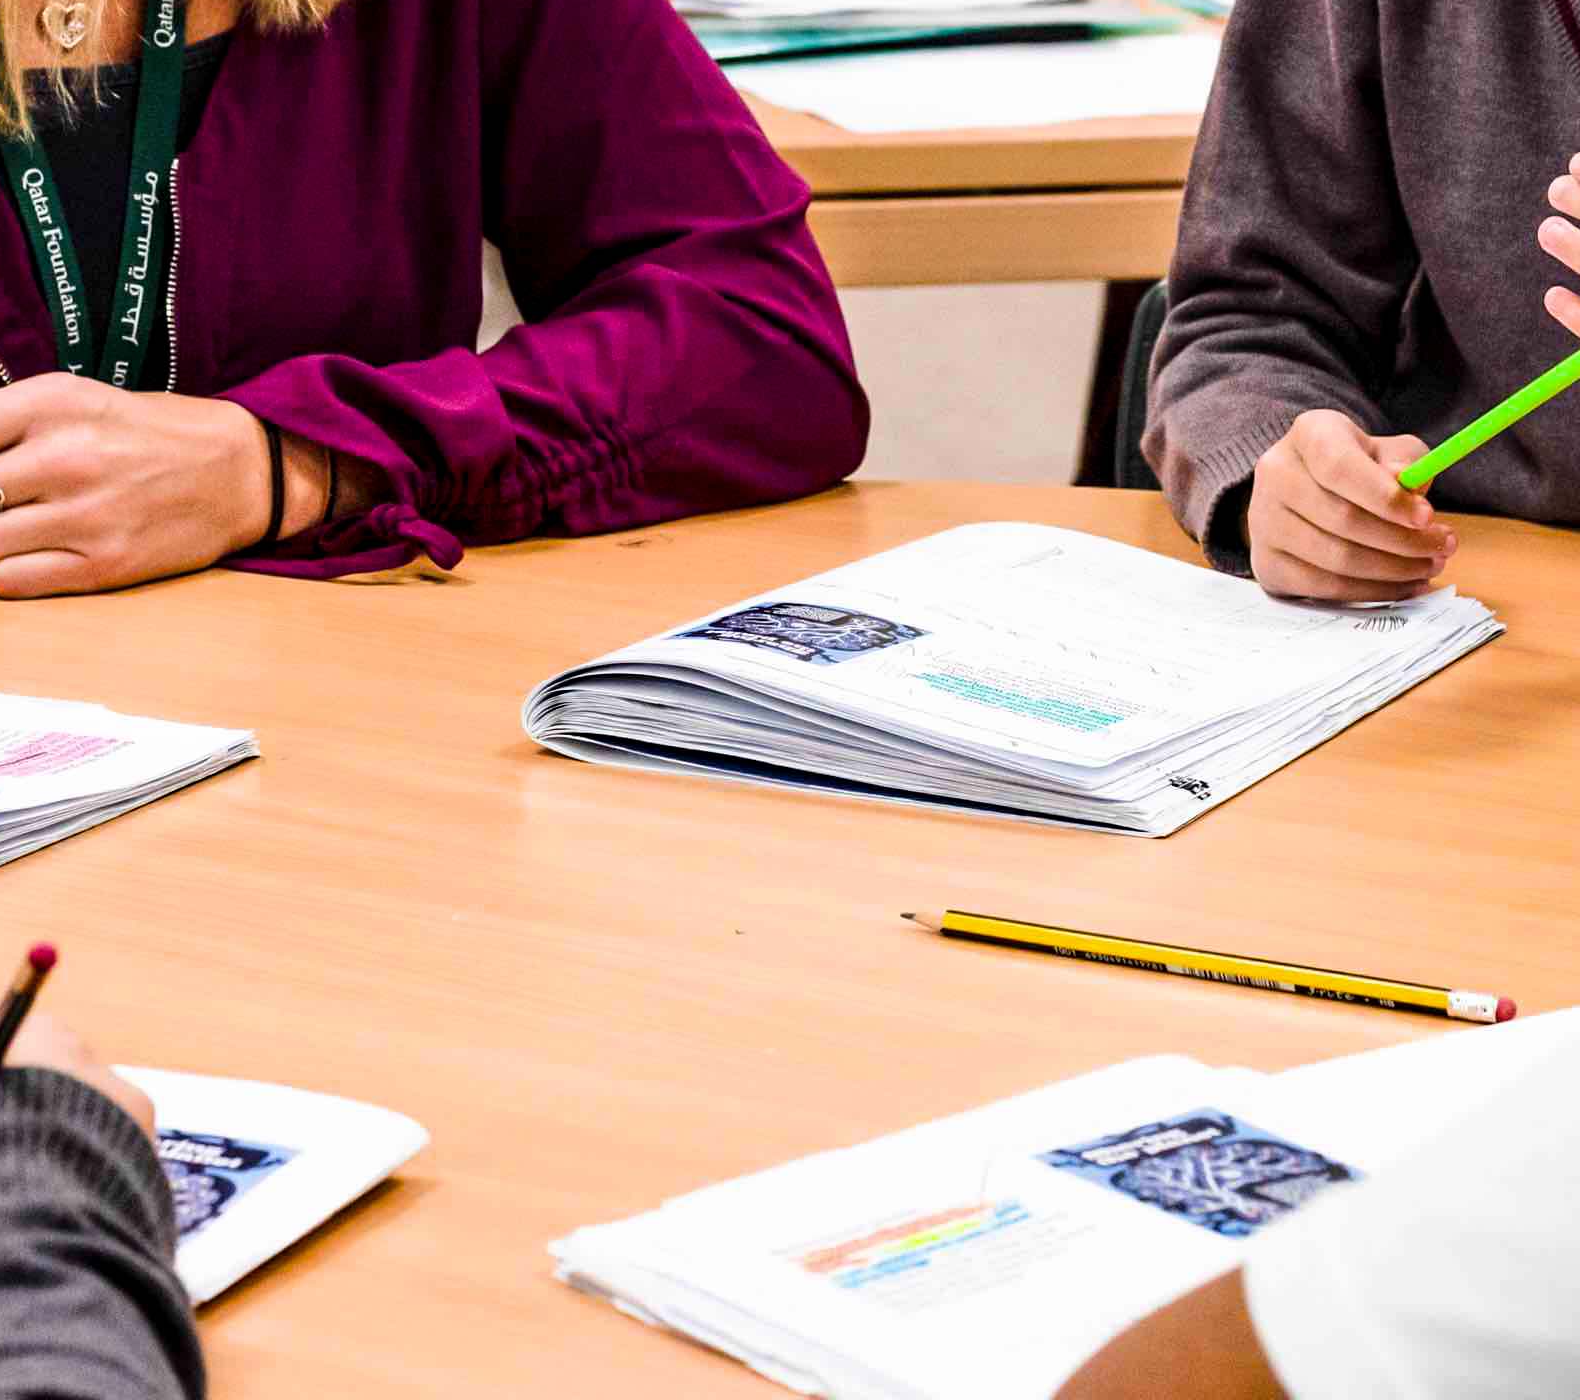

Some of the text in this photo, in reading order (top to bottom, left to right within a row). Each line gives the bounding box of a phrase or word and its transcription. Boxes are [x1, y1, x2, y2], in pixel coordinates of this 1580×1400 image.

[22, 167, 52, 225] Qatar
[42, 226, 81, 345] Foundation
[121, 171, 159, 347] مؤسسة قطر
